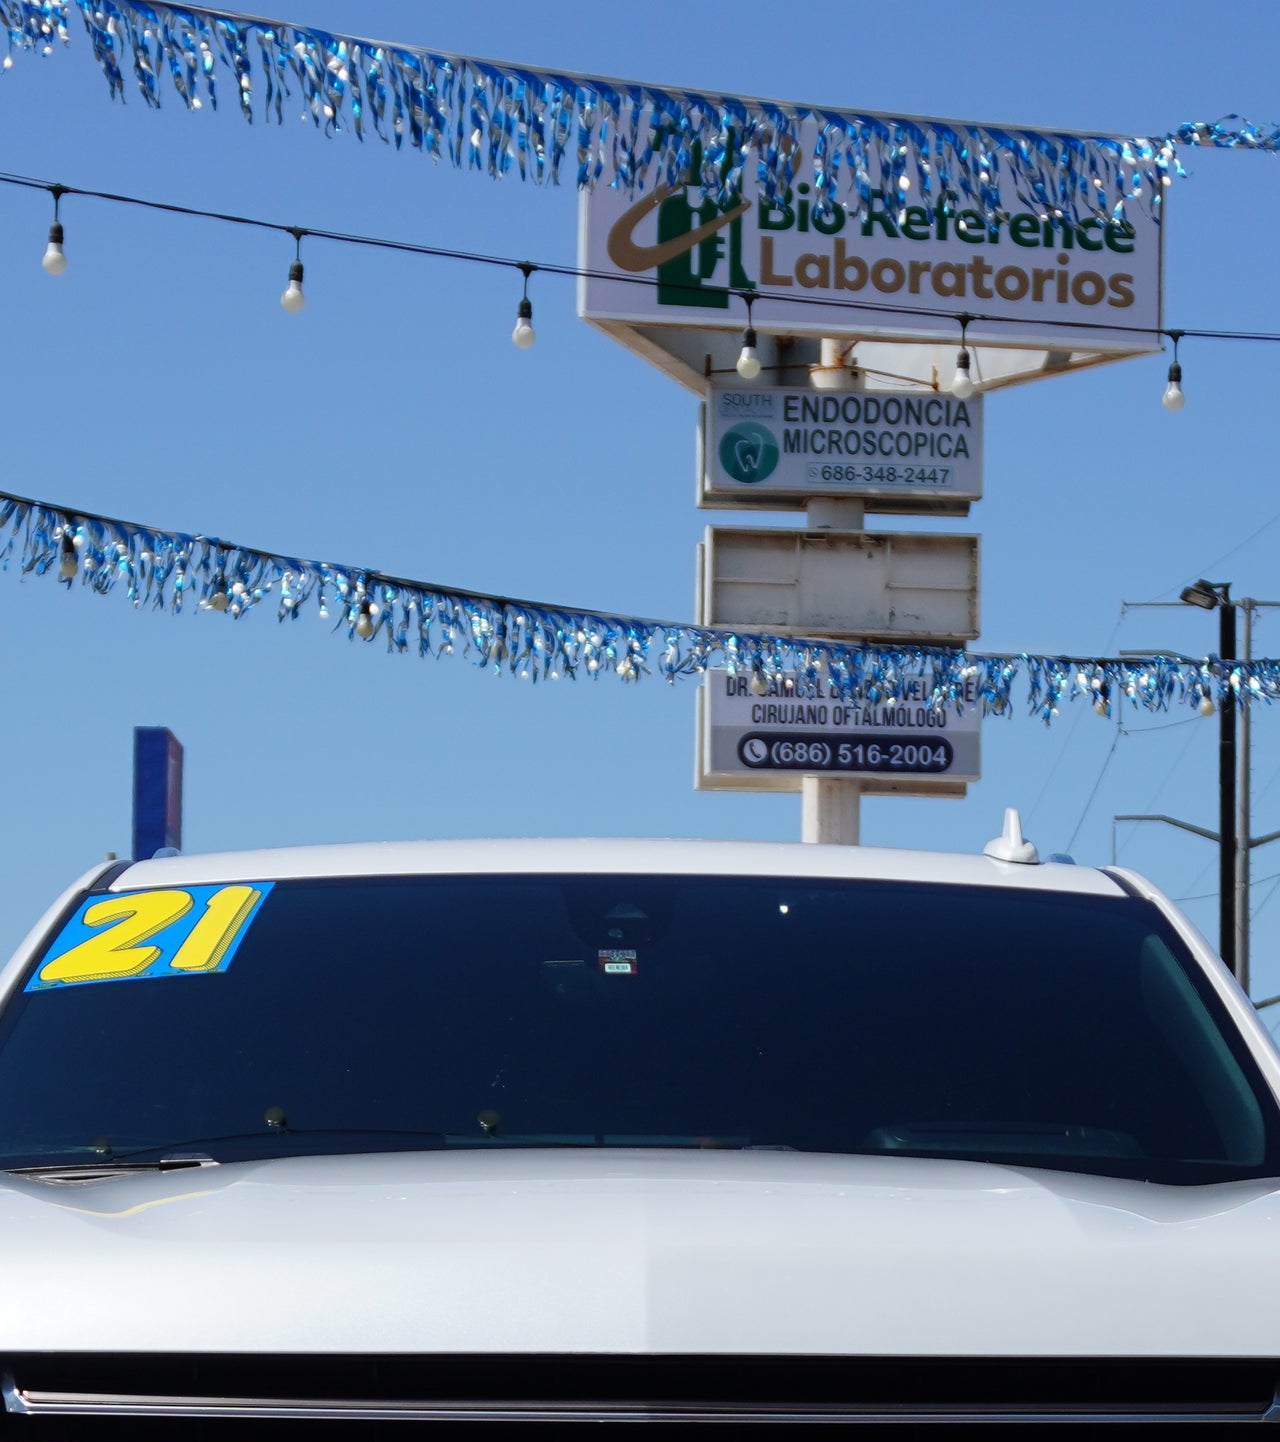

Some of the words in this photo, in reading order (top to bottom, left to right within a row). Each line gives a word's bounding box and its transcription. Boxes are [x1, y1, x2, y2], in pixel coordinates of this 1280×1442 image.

[759, 235, 1135, 308] Laboratorios
[782, 394, 971, 428] ENDODONCIA
[782, 428, 970, 459] MICROSCOPICA
[821, 464, 950, 485] 686-348-2447
[752, 702, 828, 725] CIRUJANO
[832, 702, 947, 728] OFTALMÓLOGO
[771, 740, 832, 765] (686)
[837, 743, 948, 767] 516-2004
[38, 885, 263, 984] 21
